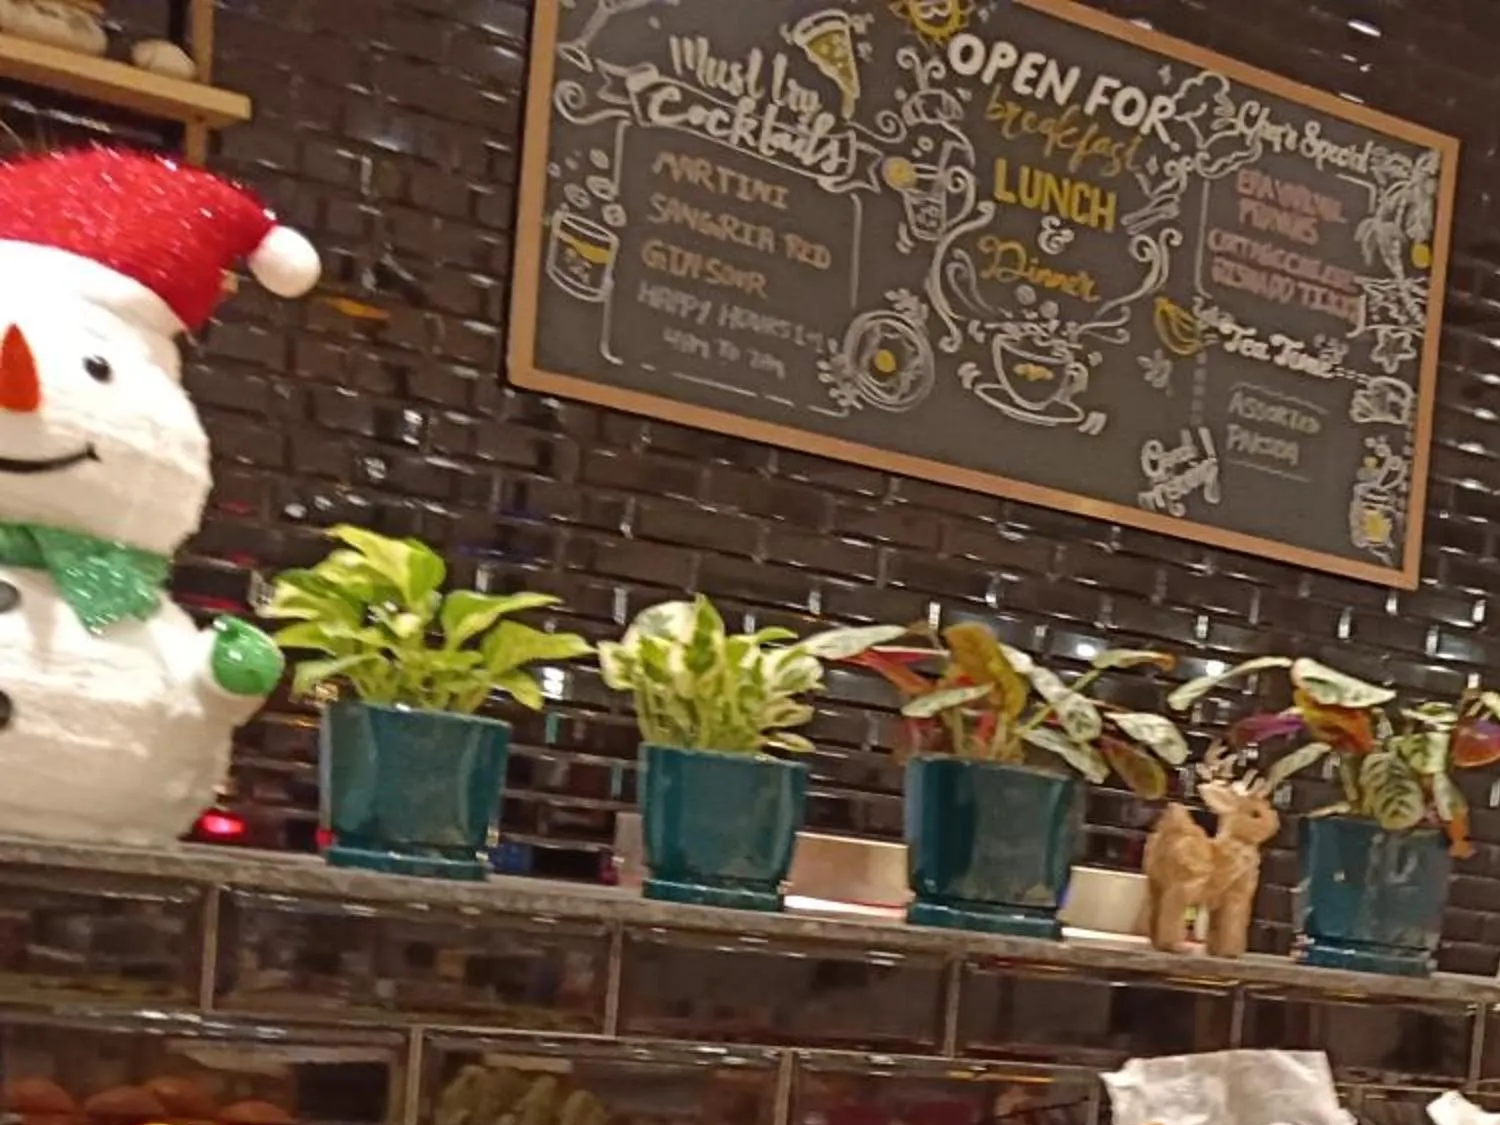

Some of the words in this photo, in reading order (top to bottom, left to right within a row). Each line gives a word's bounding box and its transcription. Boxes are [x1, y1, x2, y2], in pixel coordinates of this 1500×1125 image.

[648, 86, 846, 172] Cocktails
[948, 33, 1081, 106] OPEN
[1084, 75, 1181, 153] FOR
[652, 151, 789, 209] MARTINI
[994, 159, 1117, 233] LUNCH
[647, 192, 775, 254] SANGRIA
[782, 232, 832, 271] RED
[1037, 216, 1074, 254] &
[977, 236, 1100, 303] Dinner
